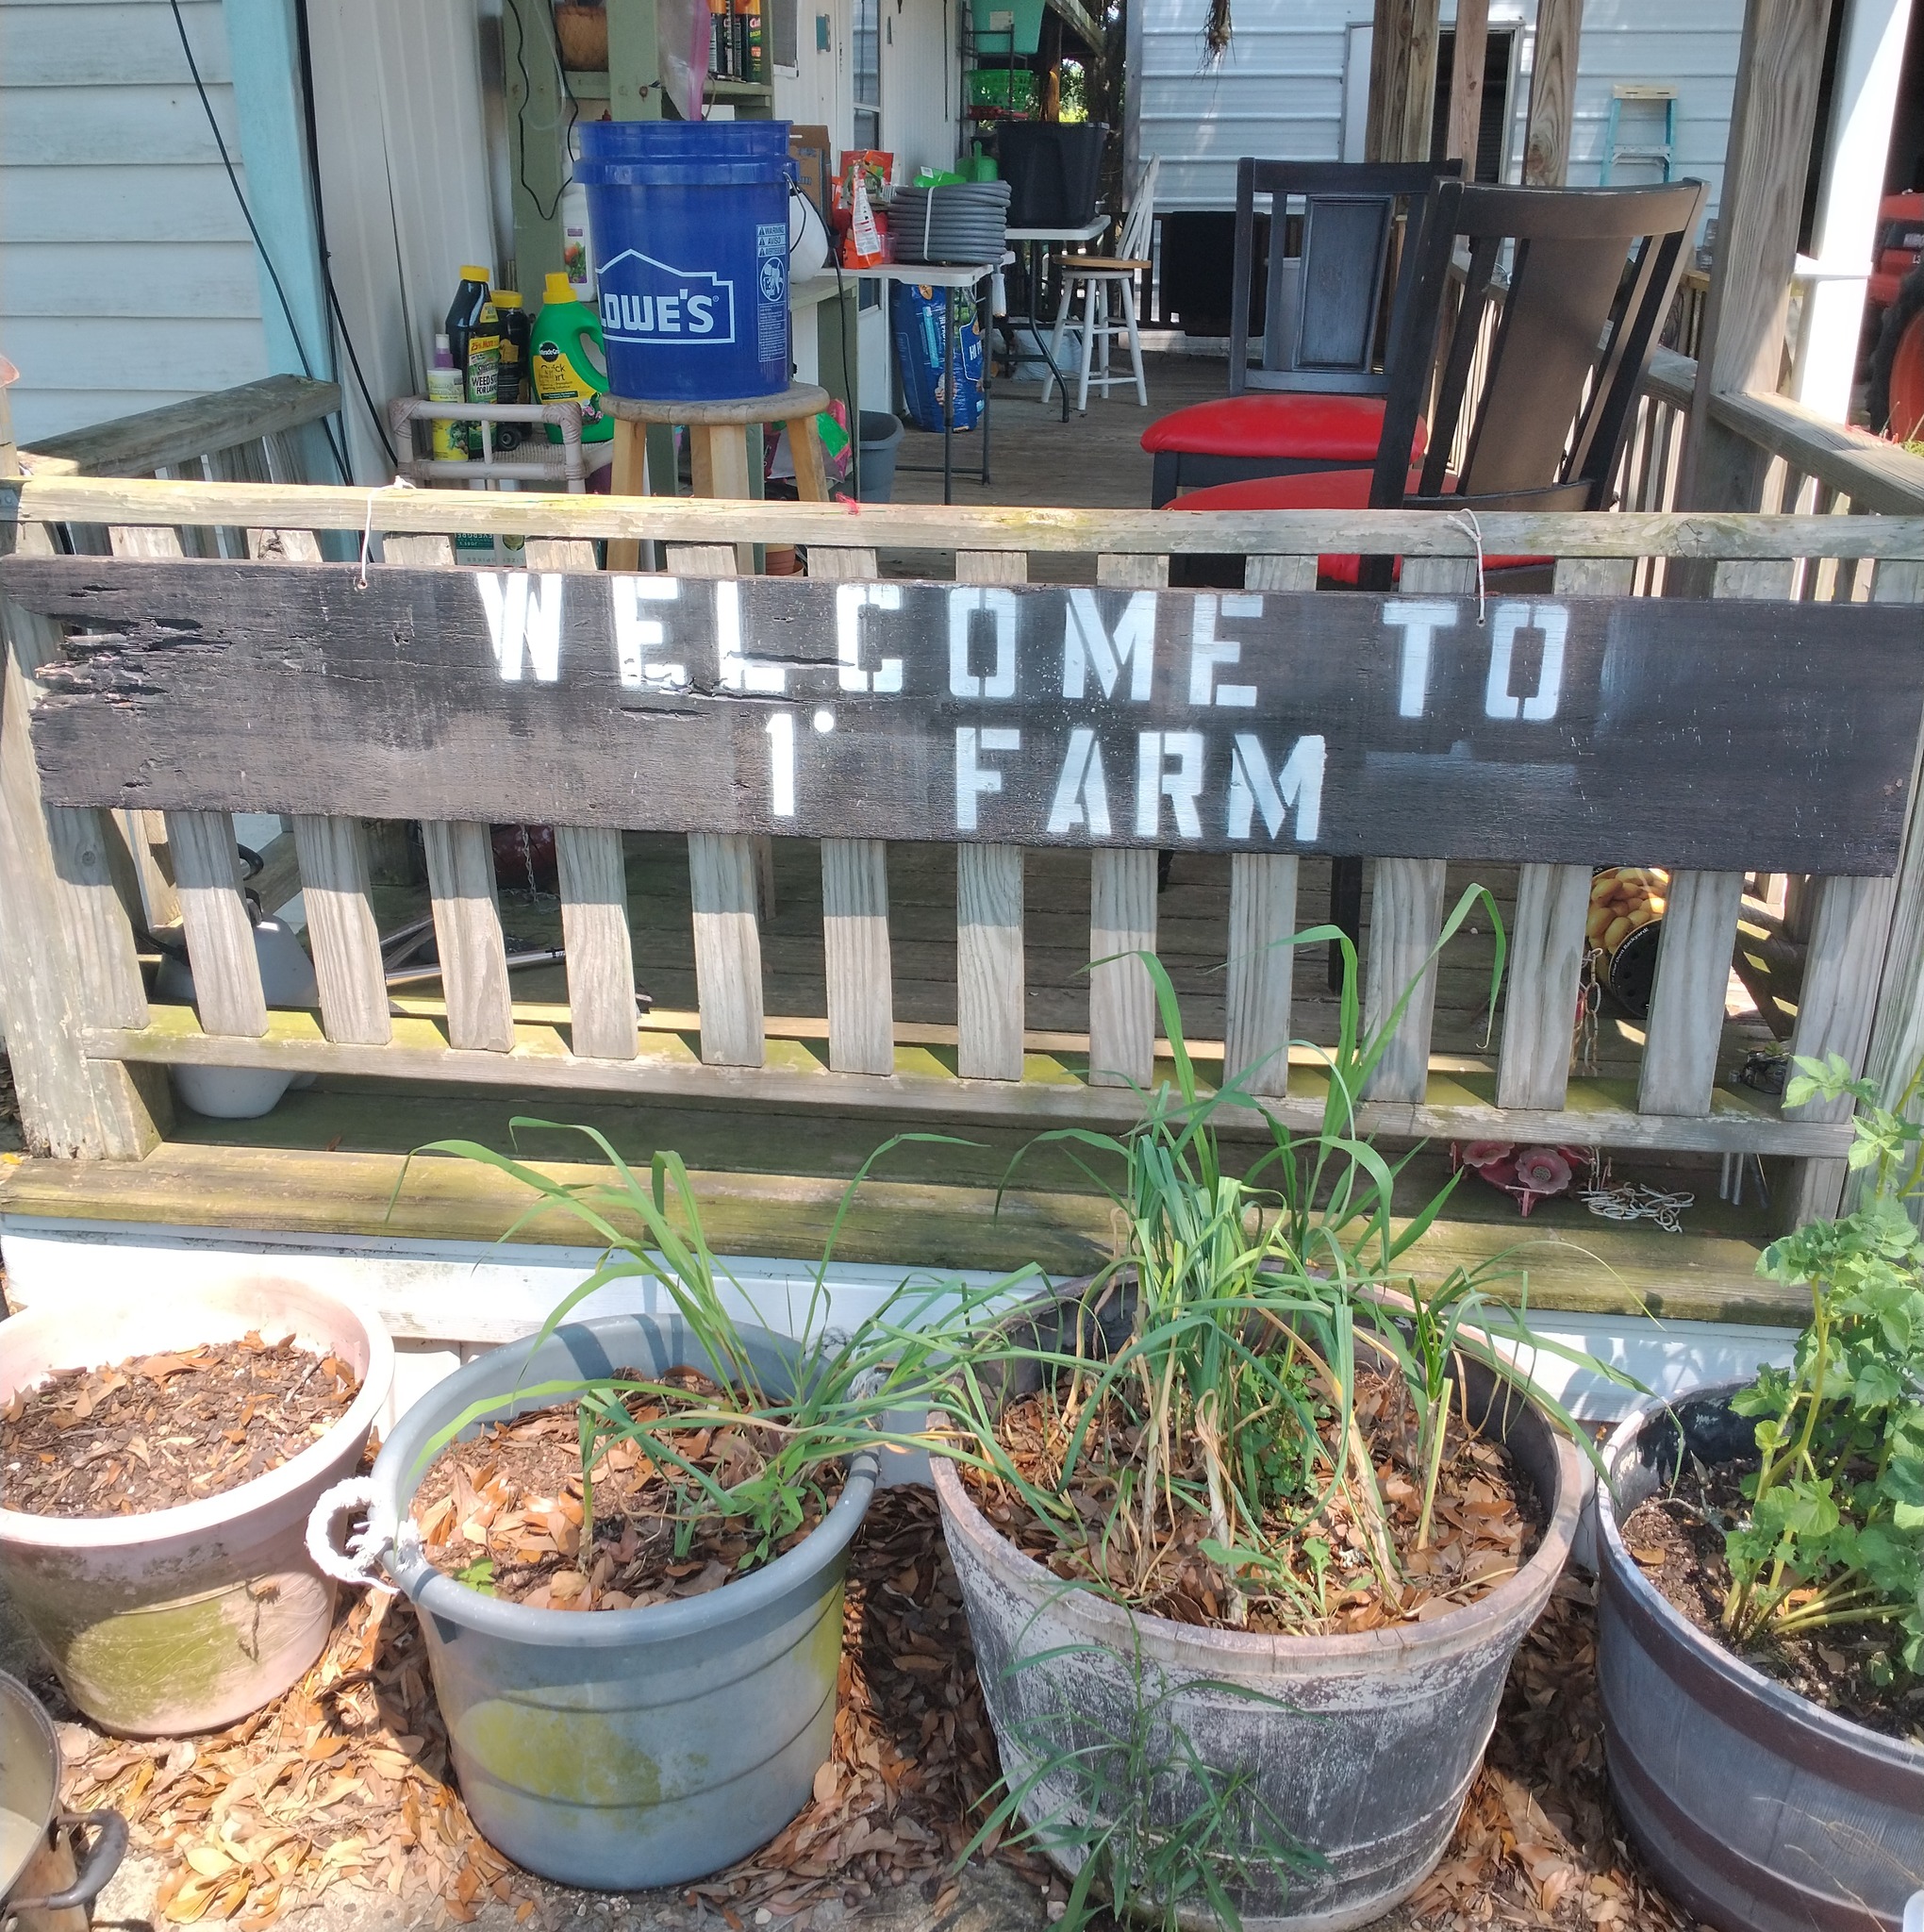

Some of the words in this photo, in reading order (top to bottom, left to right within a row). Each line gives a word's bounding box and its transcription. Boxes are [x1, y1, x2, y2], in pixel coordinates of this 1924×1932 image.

[472, 375, 490, 386] WEED
[476, 571, 1265, 708] WELCOME
[1383, 600, 1570, 721] TO
[956, 726, 1326, 841] FARM
